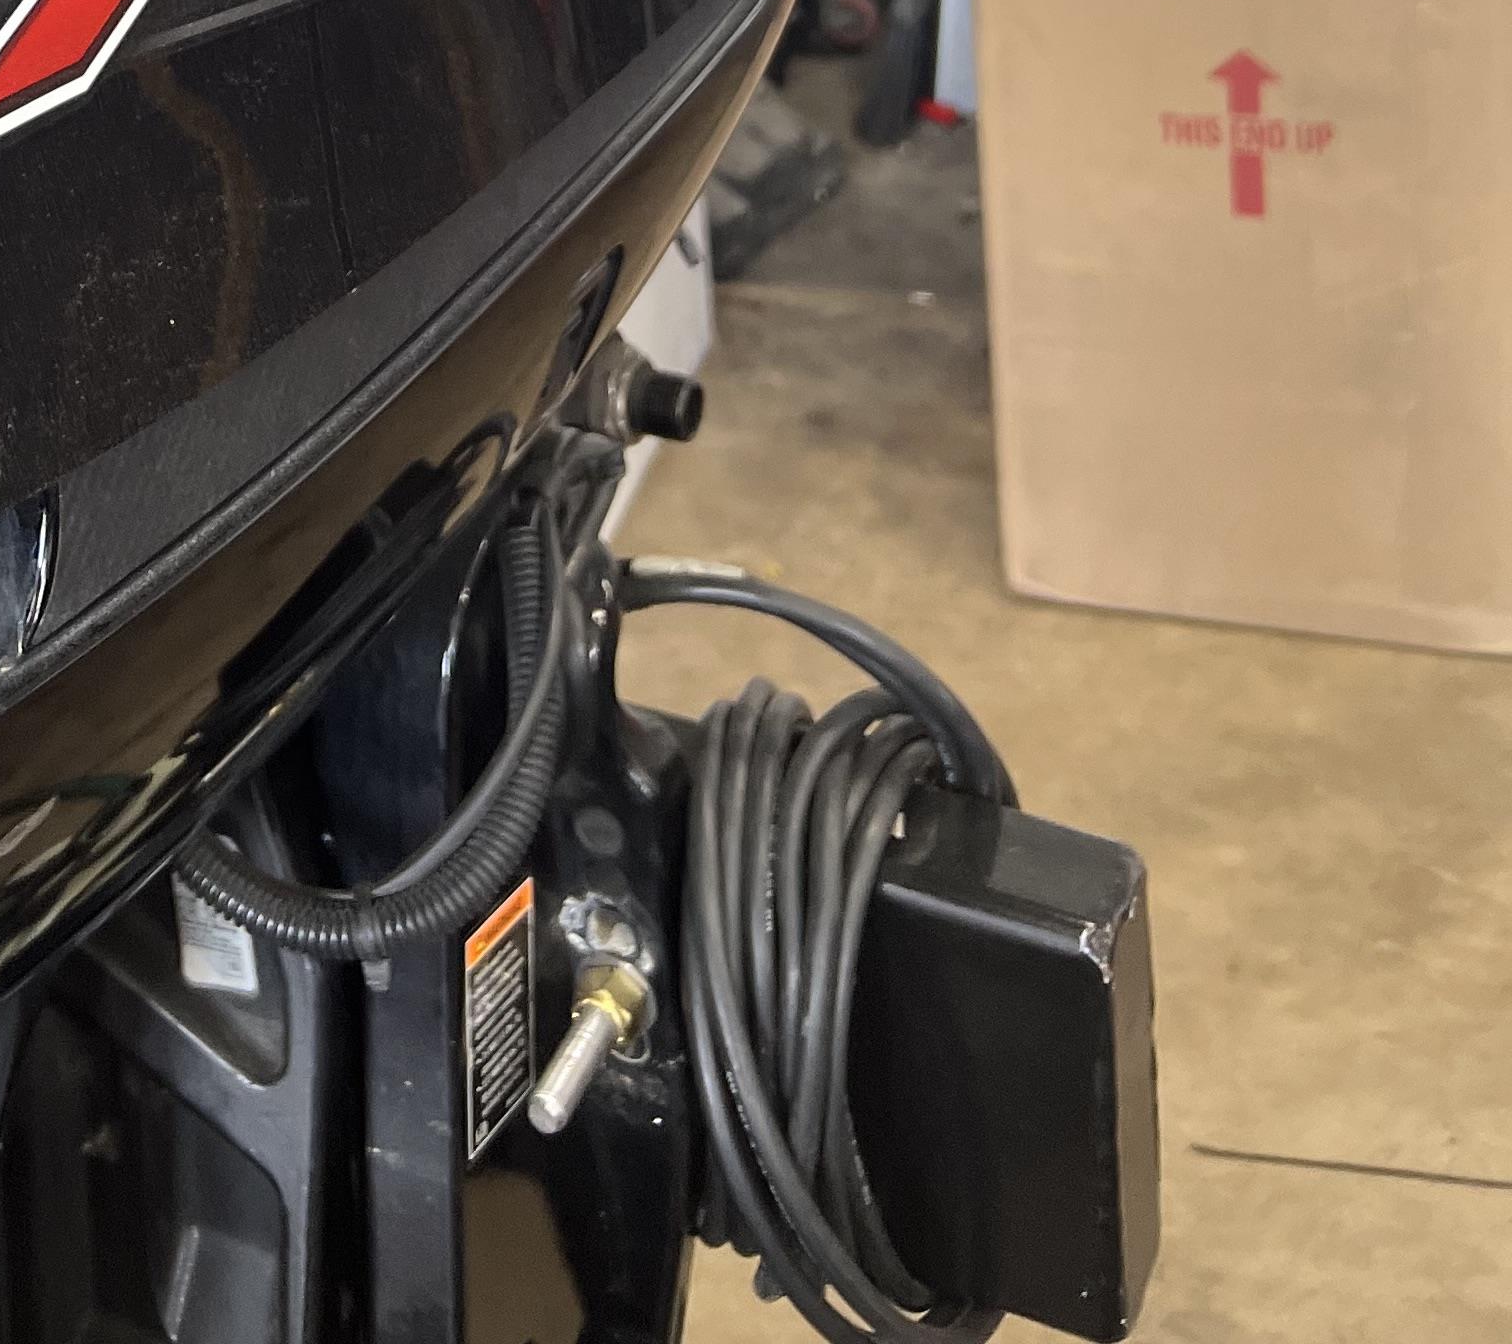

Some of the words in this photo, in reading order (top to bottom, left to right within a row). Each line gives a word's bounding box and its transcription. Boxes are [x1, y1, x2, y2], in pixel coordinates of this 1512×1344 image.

[1158, 111, 1221, 150] THIS
[1228, 115, 1288, 155] END
[1294, 119, 1335, 155] UP
